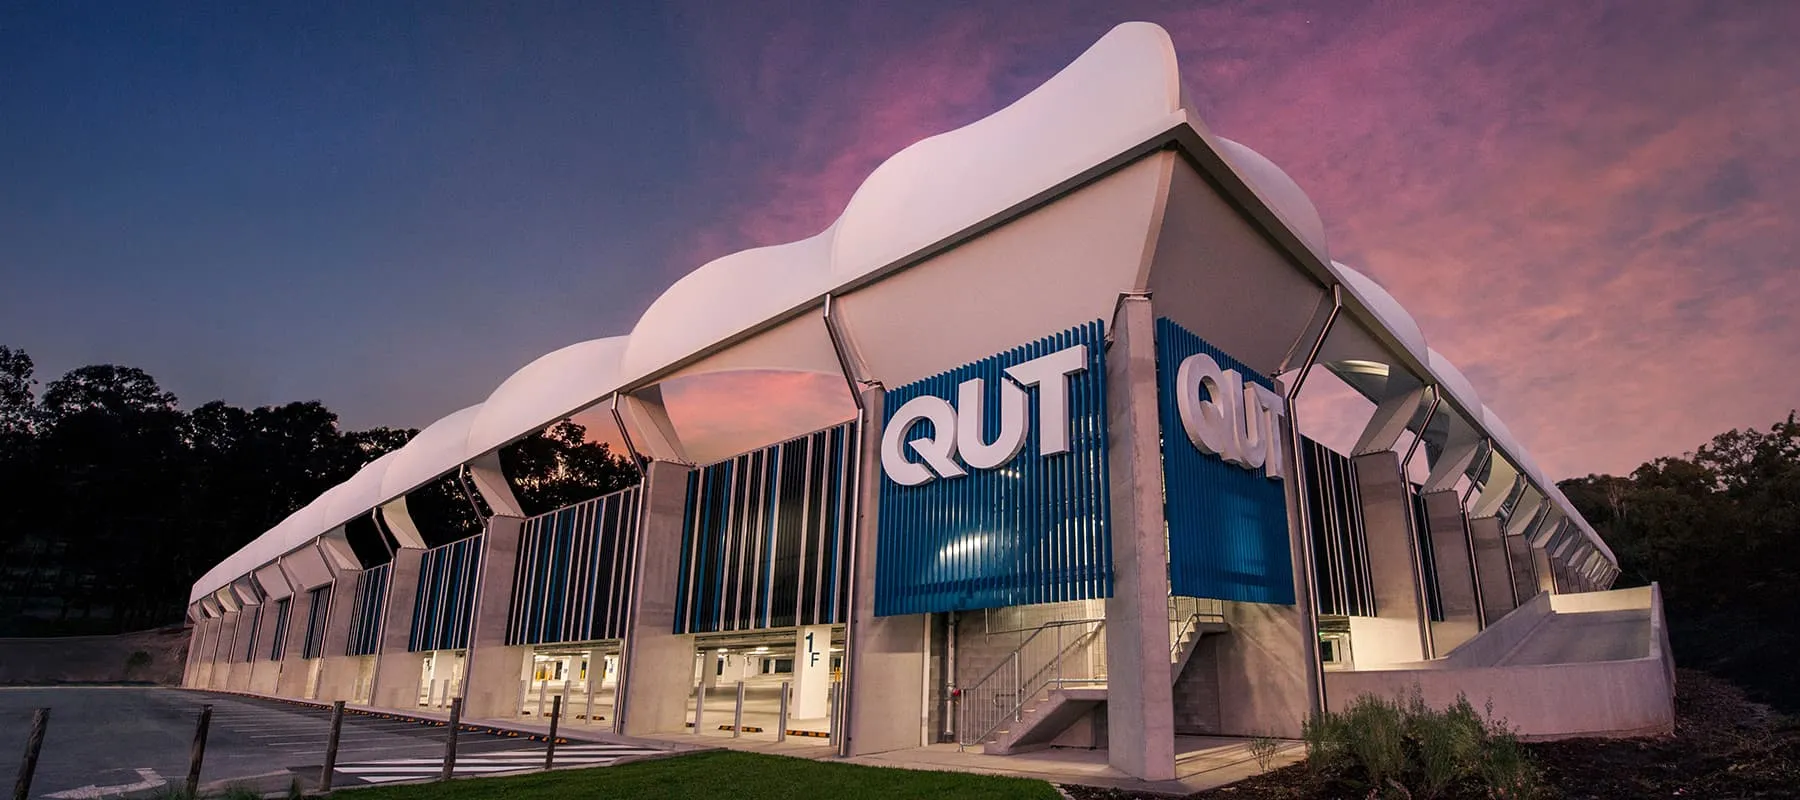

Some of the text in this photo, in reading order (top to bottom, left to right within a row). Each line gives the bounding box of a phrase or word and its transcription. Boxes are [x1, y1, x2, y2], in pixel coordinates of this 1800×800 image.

[880, 344, 1088, 487] QUT
[1176, 353, 1285, 480] QUT
[805, 632, 813, 652] 1
[811, 652, 820, 667] F
